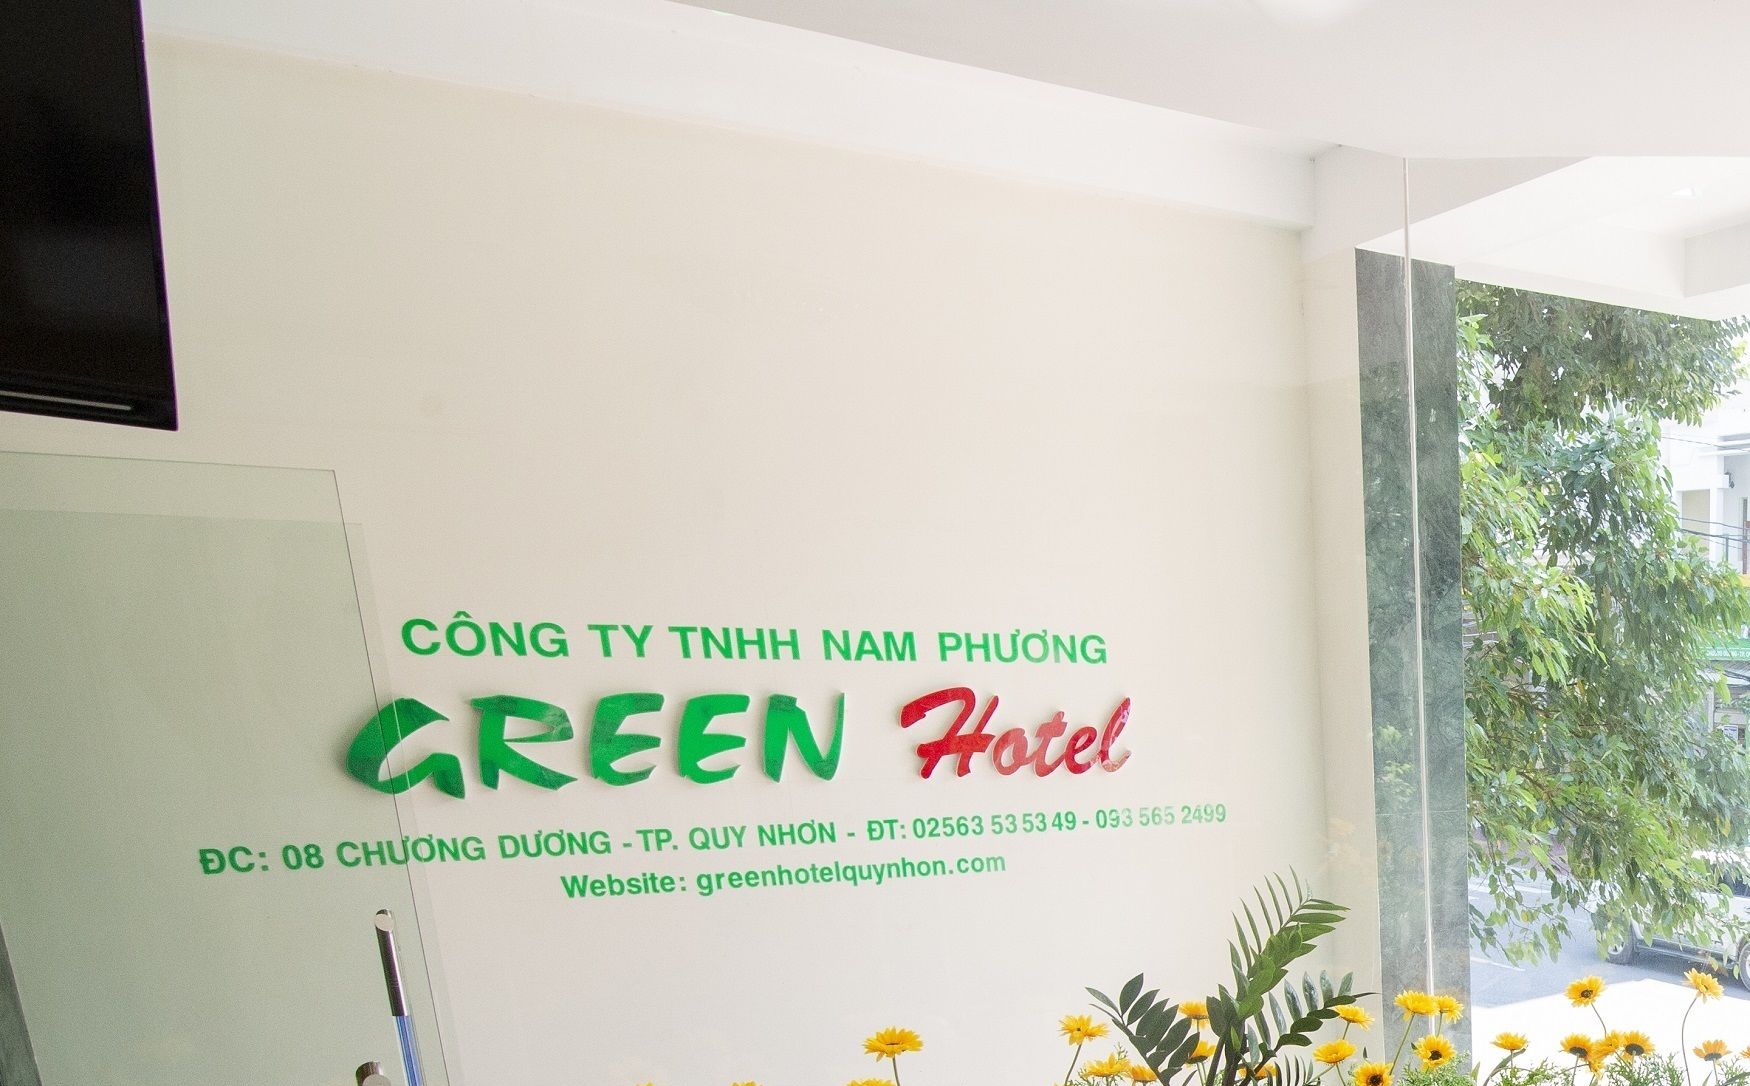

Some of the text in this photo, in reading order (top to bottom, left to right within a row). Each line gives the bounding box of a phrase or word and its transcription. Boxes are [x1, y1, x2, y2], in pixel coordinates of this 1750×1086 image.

[401, 611, 1108, 665] CÔNG TY TNHH NAM PHƯƠNG
[345, 686, 1132, 800] GREEN Hotel
[197, 844, 270, 877] ĐC:
[280, 843, 326, 871] 08
[336, 834, 487, 869] CHƯƠNG
[497, 828, 613, 860] DƯƠNG
[641, 827, 680, 853] TP.
[687, 824, 748, 853] QUY
[756, 817, 839, 849] NHƠN
[865, 816, 908, 843] ĐT:
[910, 814, 985, 840] 02563
[1094, 807, 1134, 830] 093
[1138, 806, 1177, 828] 565
[1180, 803, 1228, 825] 2499
[560, 853, 1007, 900] Website: greenhotelquynhon.com
